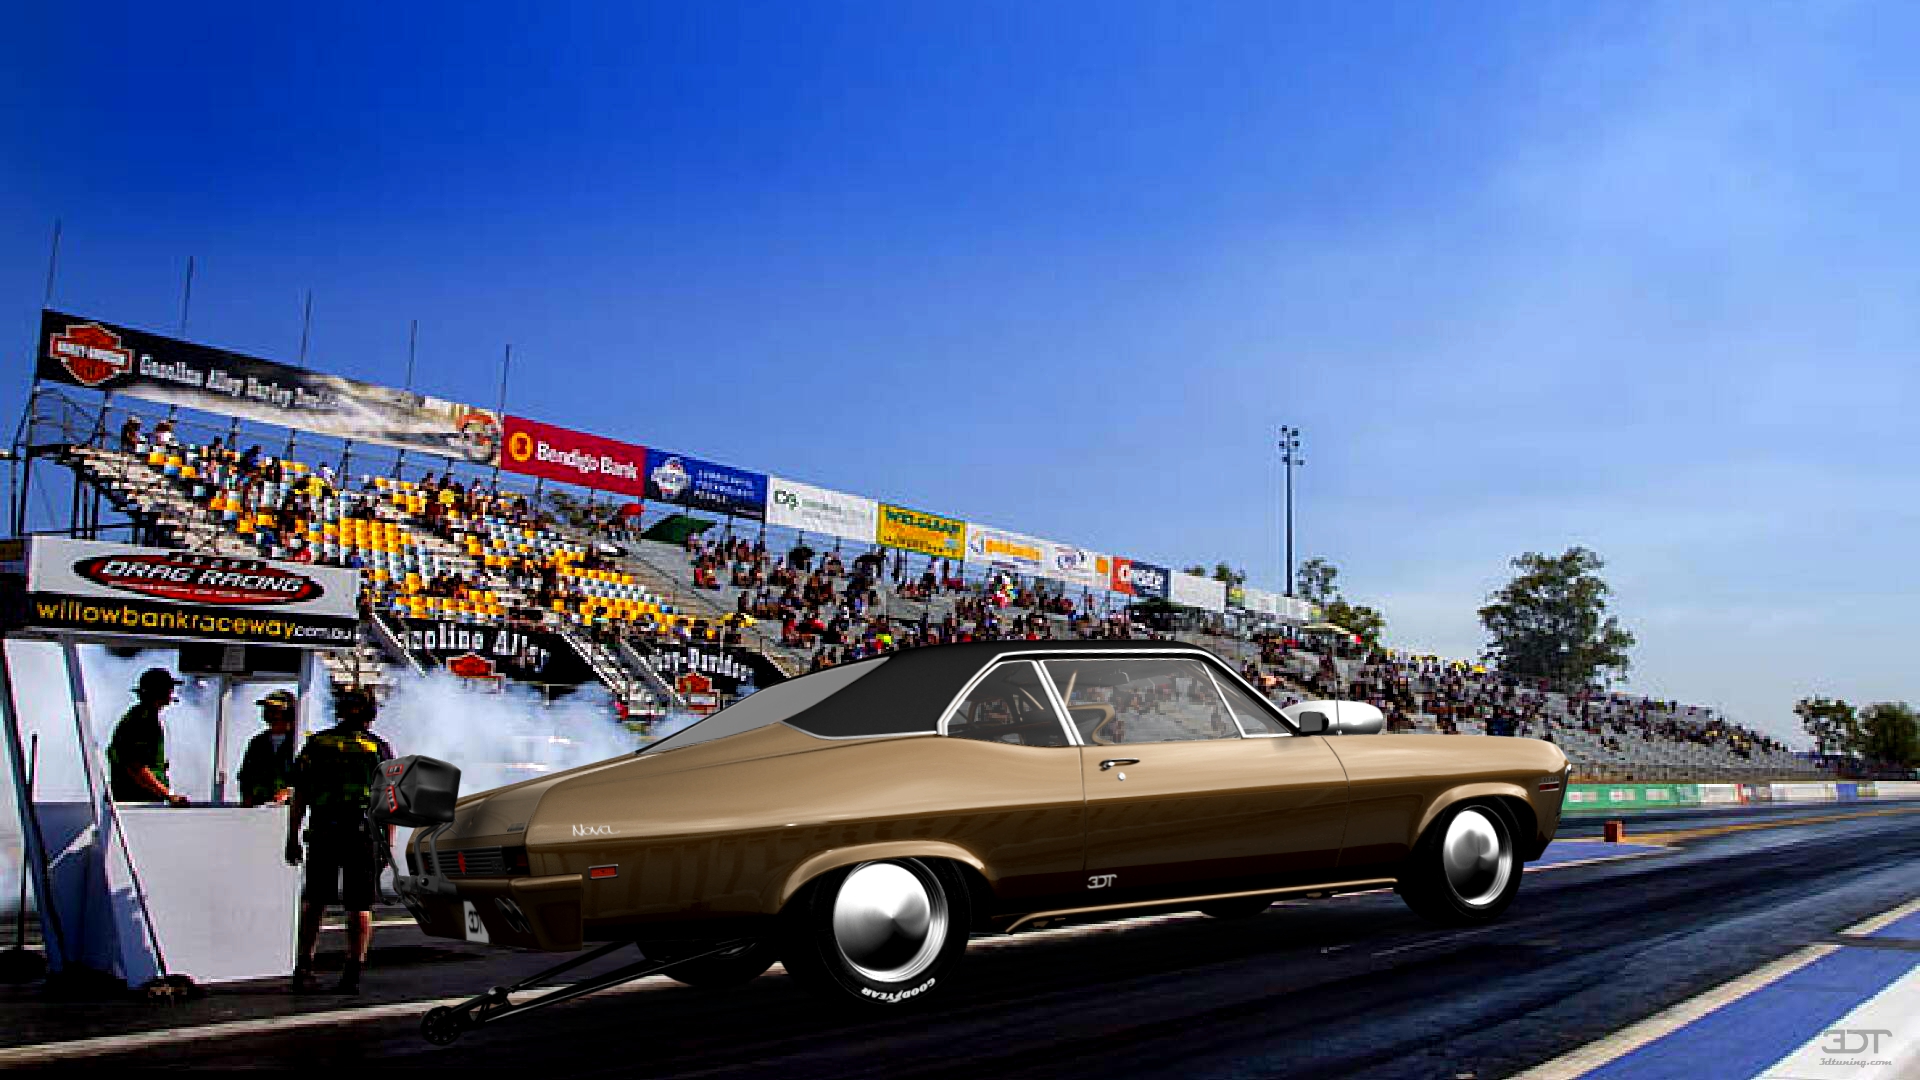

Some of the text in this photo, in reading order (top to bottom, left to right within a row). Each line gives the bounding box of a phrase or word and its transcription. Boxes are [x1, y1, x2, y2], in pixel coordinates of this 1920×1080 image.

[536, 440, 600, 473] Bendigo
[600, 455, 639, 481] Bank
[101, 560, 196, 582] DRAG
[198, 570, 305, 593] RACING
[572, 823, 620, 838] Nova
[1087, 874, 1117, 889] 3DT
[861, 977, 936, 1004] GOODYEAR
